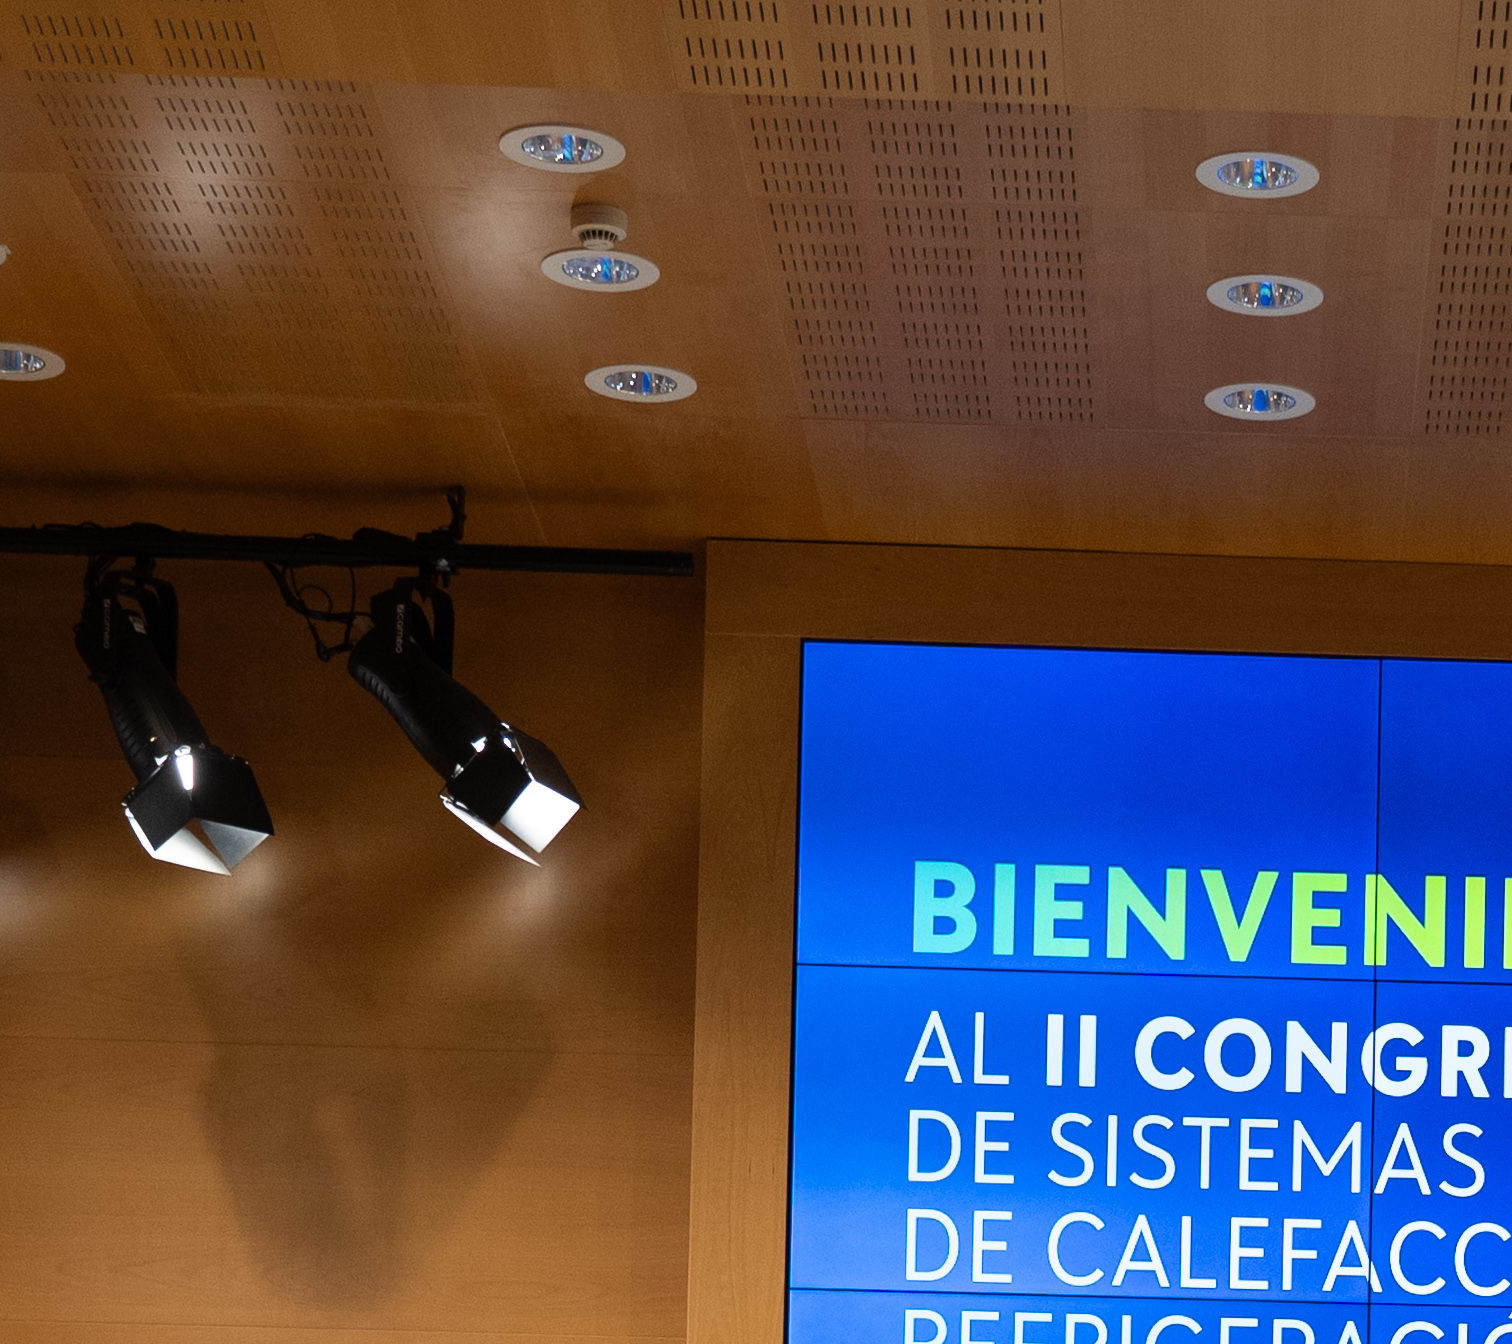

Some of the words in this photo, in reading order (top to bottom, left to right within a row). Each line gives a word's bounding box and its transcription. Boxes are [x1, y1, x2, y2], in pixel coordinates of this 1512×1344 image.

[905, 1011, 1009, 1084] AL
[1046, 1014, 1096, 1087] II
[908, 1110, 1014, 1184] DE
[1048, 1113, 1485, 1197] SISTEMAS
[906, 1209, 1012, 1283] DE
